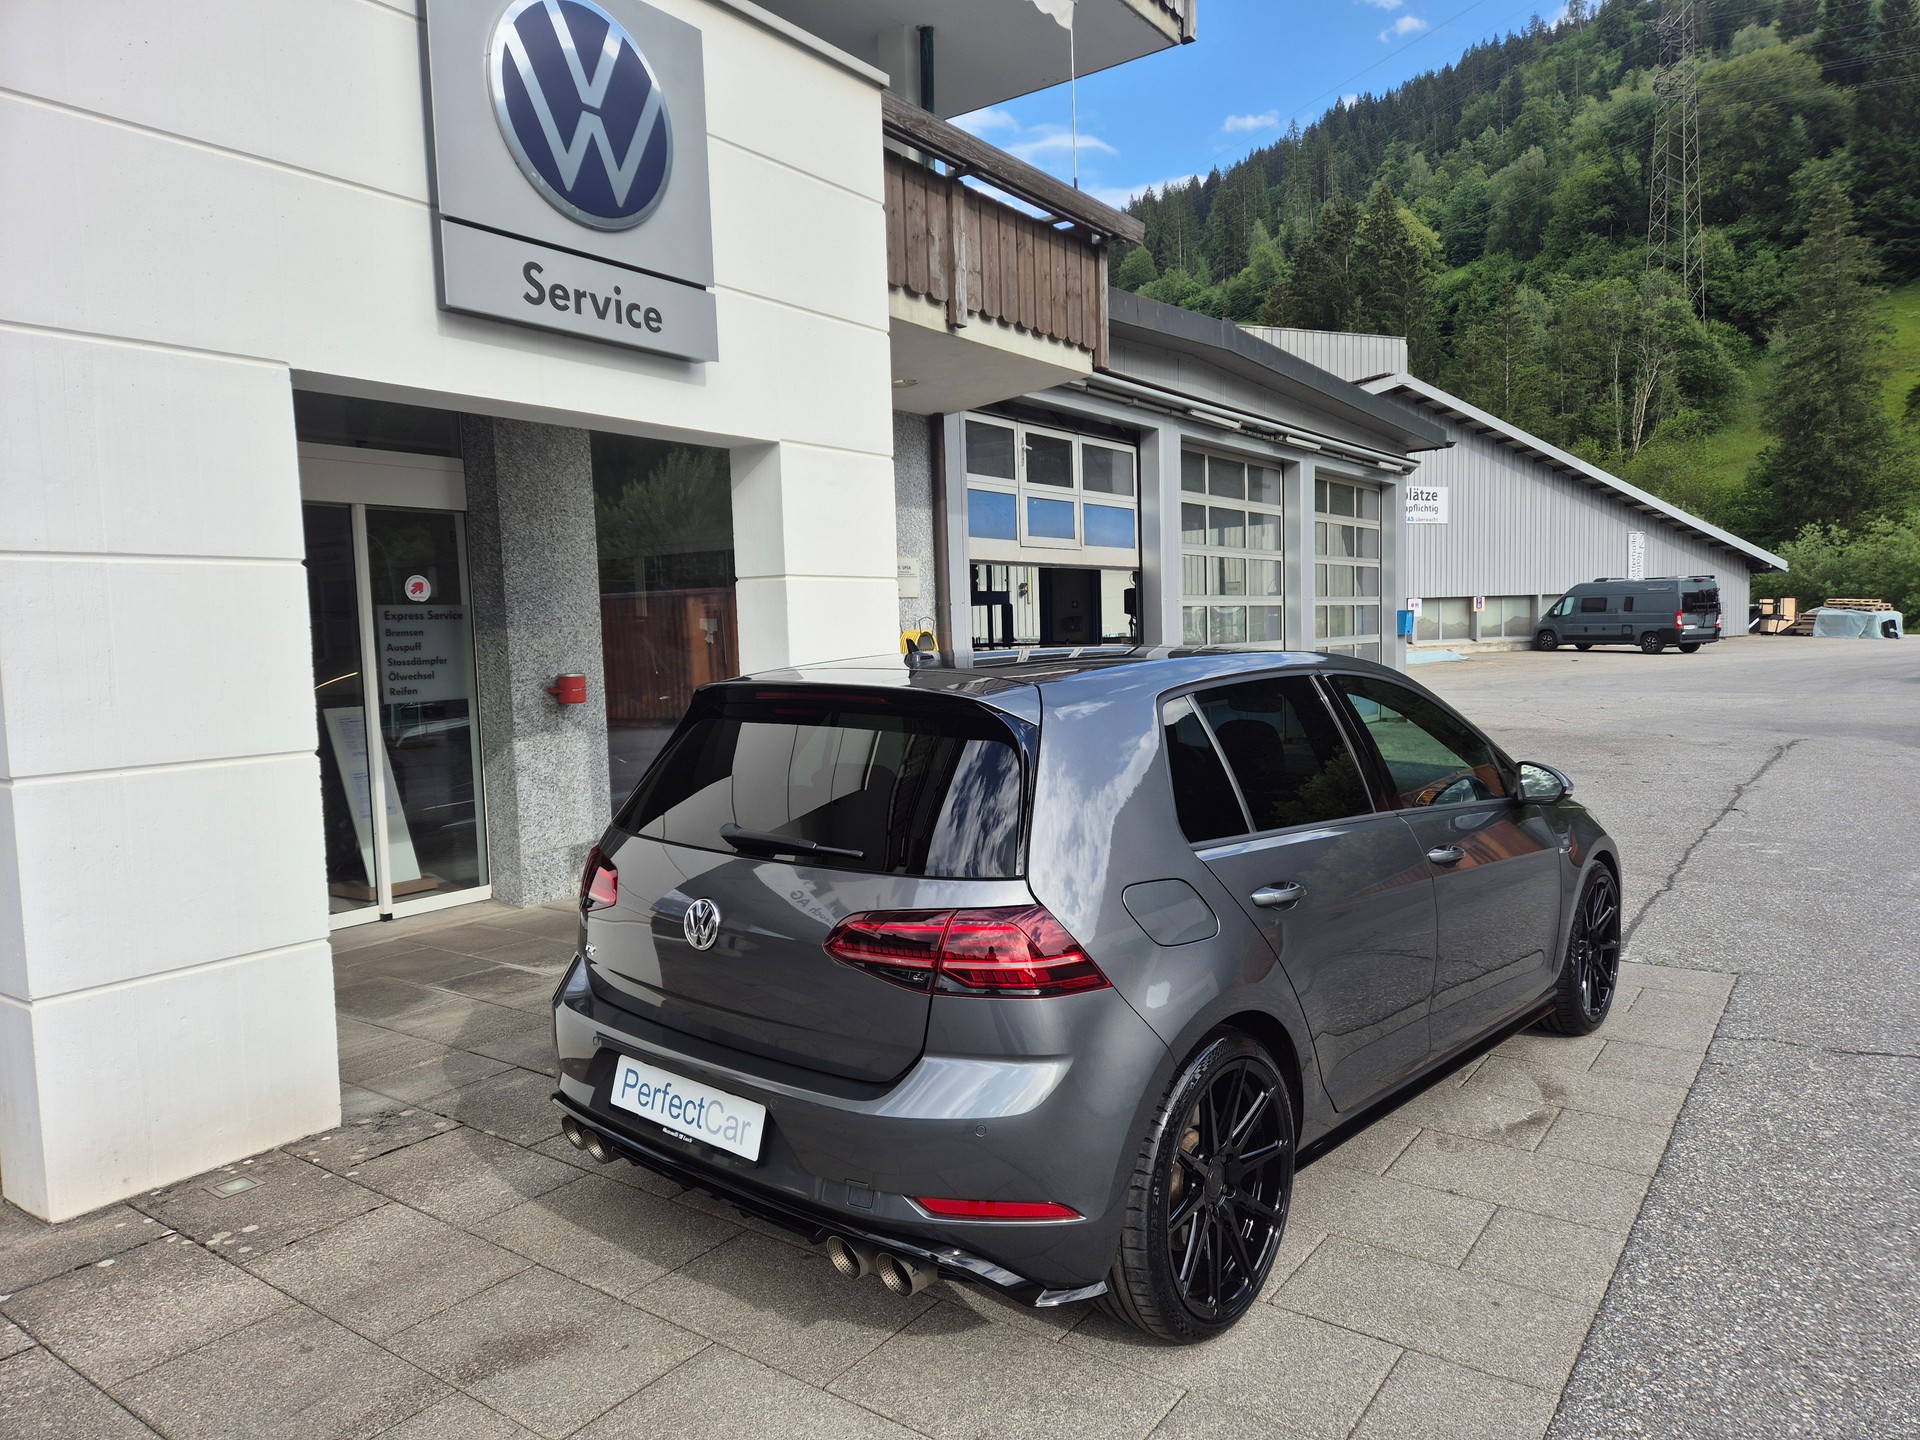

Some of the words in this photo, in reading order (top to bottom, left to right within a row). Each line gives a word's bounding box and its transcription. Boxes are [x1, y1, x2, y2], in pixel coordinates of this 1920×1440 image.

[522, 261, 663, 334] Service
[384, 610, 424, 623] Express
[428, 610, 463, 620] Service
[385, 628, 424, 637] Bremsen
[386, 642, 422, 653] Auspuff
[387, 656, 447, 667] Stossdämpfer
[388, 670, 435, 681] Ölwechsel
[389, 687, 418, 696] Reifen
[621, 1067, 751, 1146] PerfectCar
